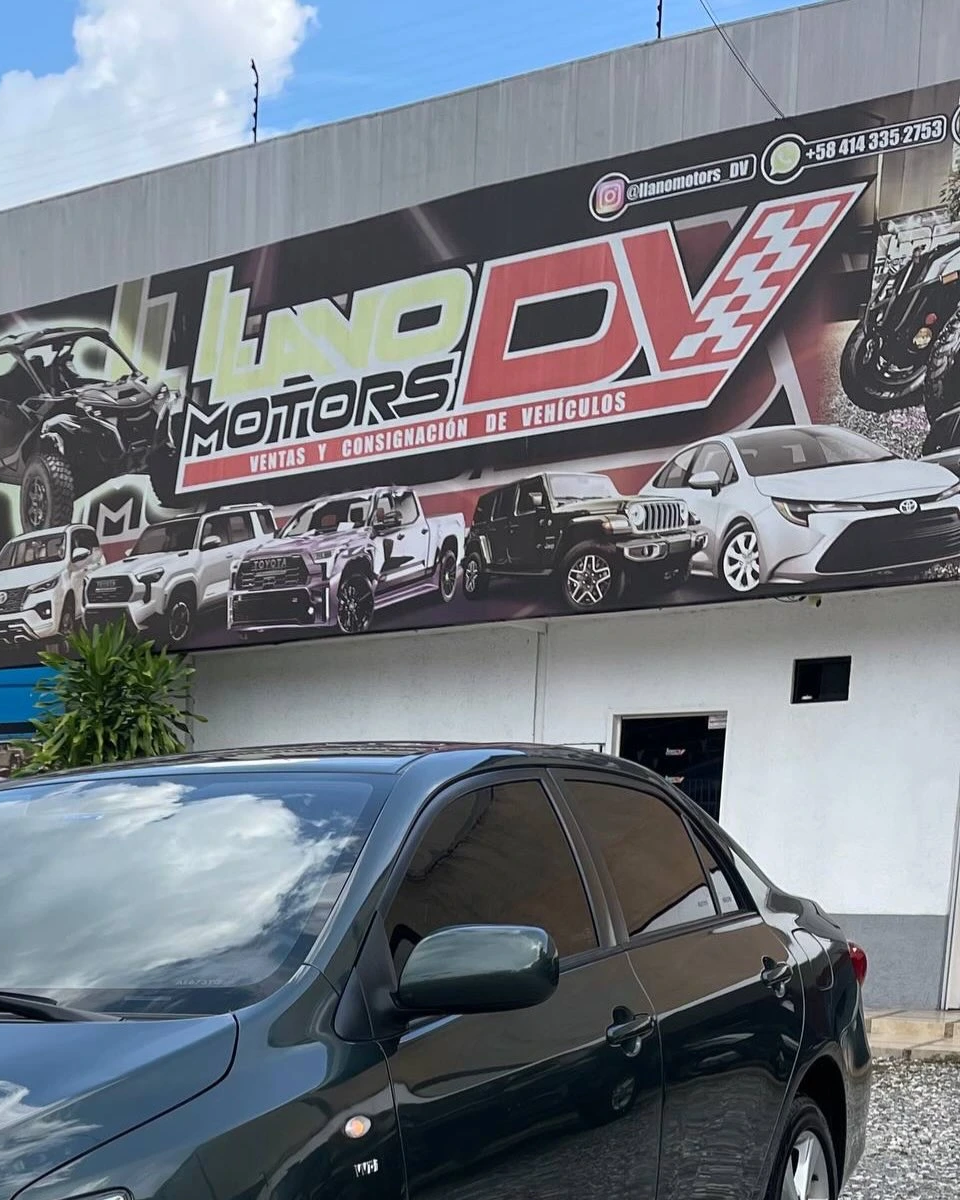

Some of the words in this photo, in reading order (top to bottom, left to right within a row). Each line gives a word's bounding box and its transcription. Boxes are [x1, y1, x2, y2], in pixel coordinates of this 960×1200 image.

[805, 141, 836, 161] +58
[838, 134, 866, 155] 414
[868, 128, 900, 150] 335
[902, 120, 943, 144] 2753
[626, 158, 750, 200] @llanomotors_DV
[462, 183, 868, 405] DV
[184, 358, 460, 459] MOTORS
[248, 447, 306, 473] VENTAS
[317, 443, 329, 463] Y
[341, 414, 469, 458] CONSIGNACIÓN
[485, 410, 508, 434] DE
[520, 390, 627, 429] VEHÍCULOS
[253, 557, 288, 570] TOYOTA
